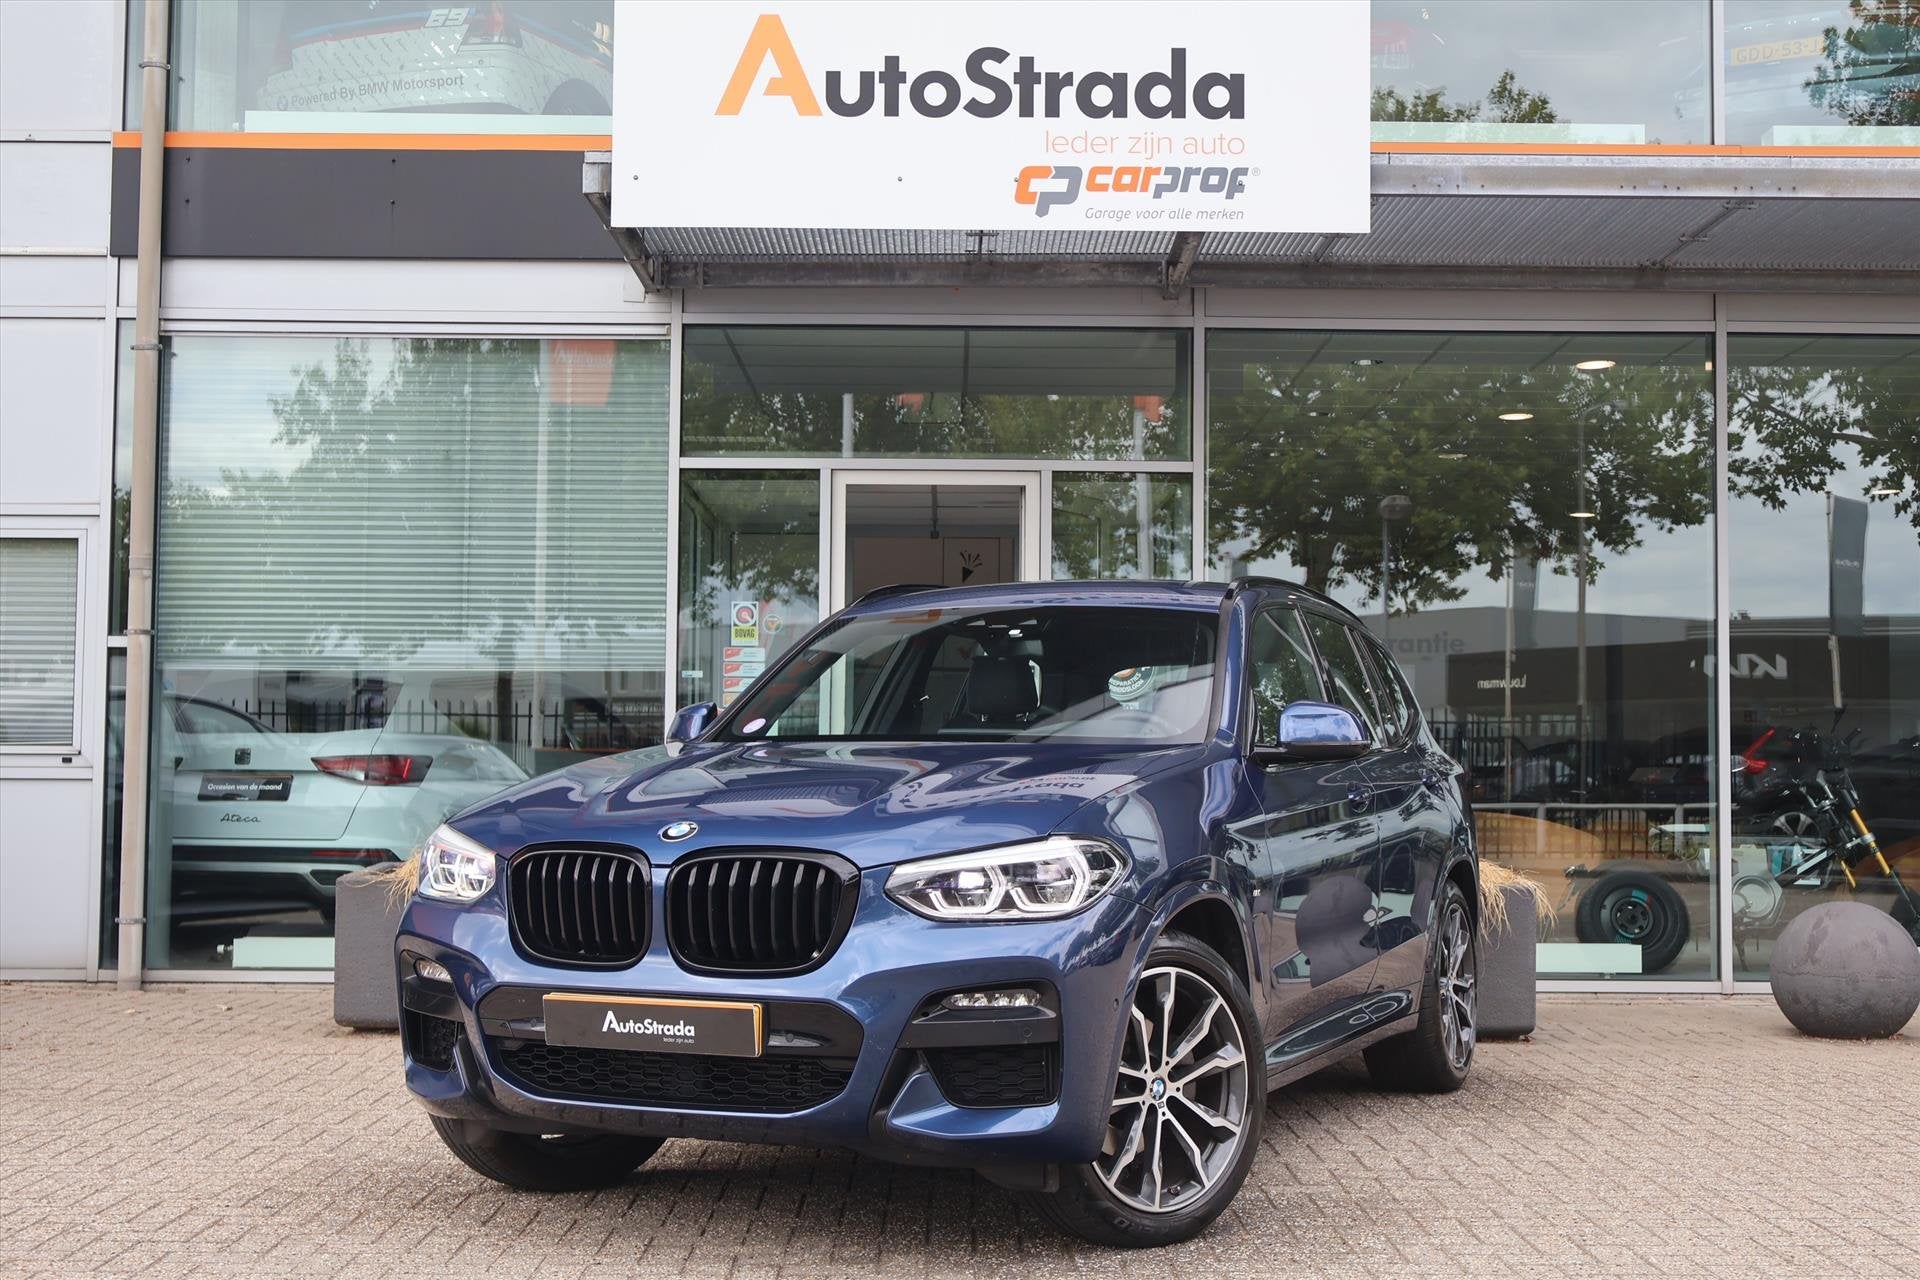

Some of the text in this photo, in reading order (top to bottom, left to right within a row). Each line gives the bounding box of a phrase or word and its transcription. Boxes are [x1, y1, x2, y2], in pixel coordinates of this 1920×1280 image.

[714, 14, 1245, 120] AutoStrada
[291, 74, 465, 106] Powered By BMW Motorsport
[1045, 130, 1246, 160] Ieder zijn auto
[1085, 207, 1245, 221] Garage voor alle merken
[734, 627, 755, 639] BOVAG
[1388, 630, 1466, 654] rantie
[249, 783, 258, 791] de
[220, 813, 261, 823] Ateca
[602, 1010, 695, 1036] AutoStrada
